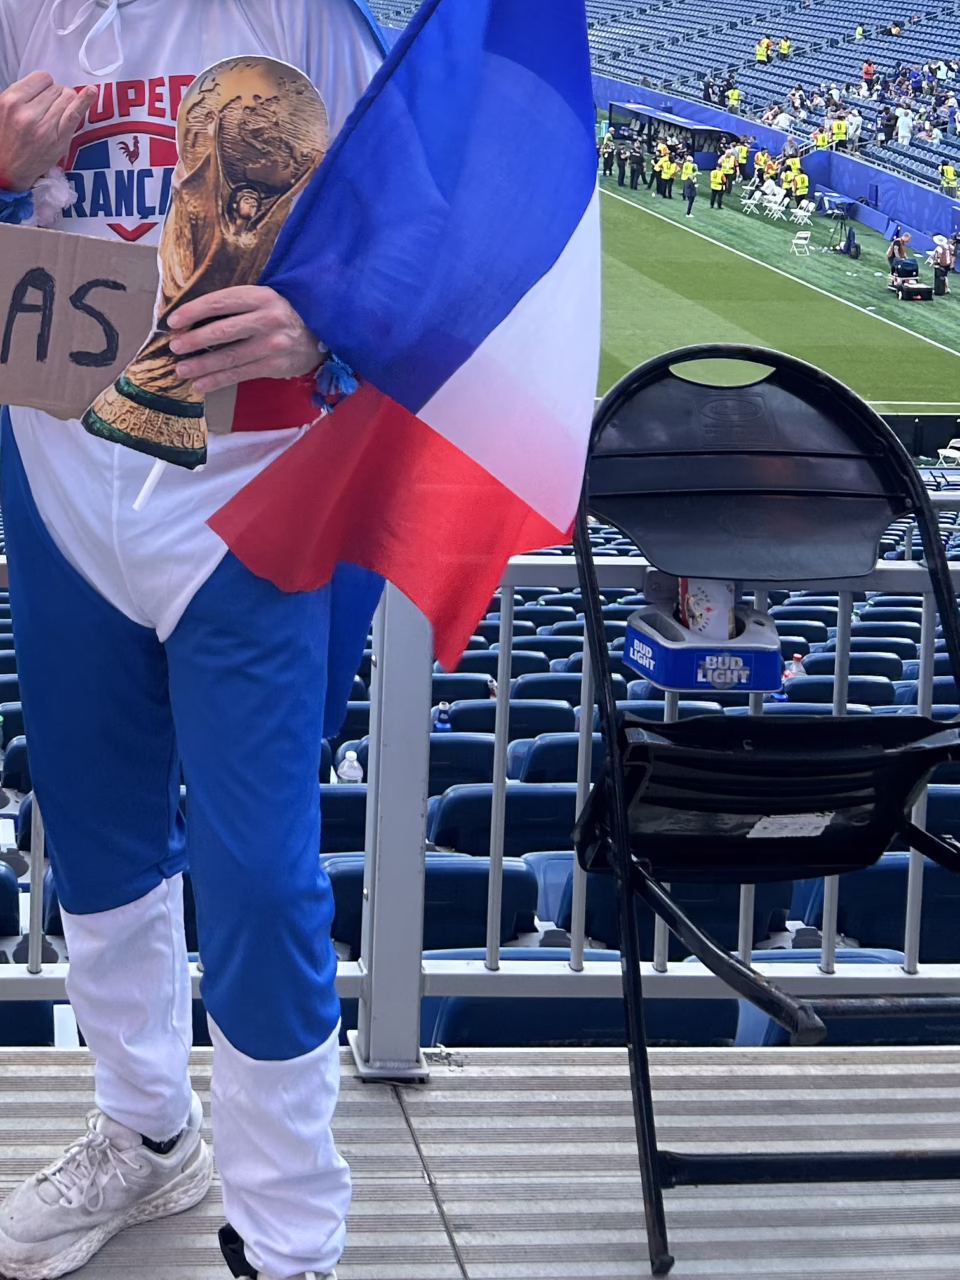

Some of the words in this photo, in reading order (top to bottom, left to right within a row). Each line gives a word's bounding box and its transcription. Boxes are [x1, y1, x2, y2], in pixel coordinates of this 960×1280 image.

[633, 638, 653, 658] BUD
[629, 647, 656, 671] LIGHT
[705, 655, 744, 670] BUD
[697, 668, 750, 684] LIGHT
